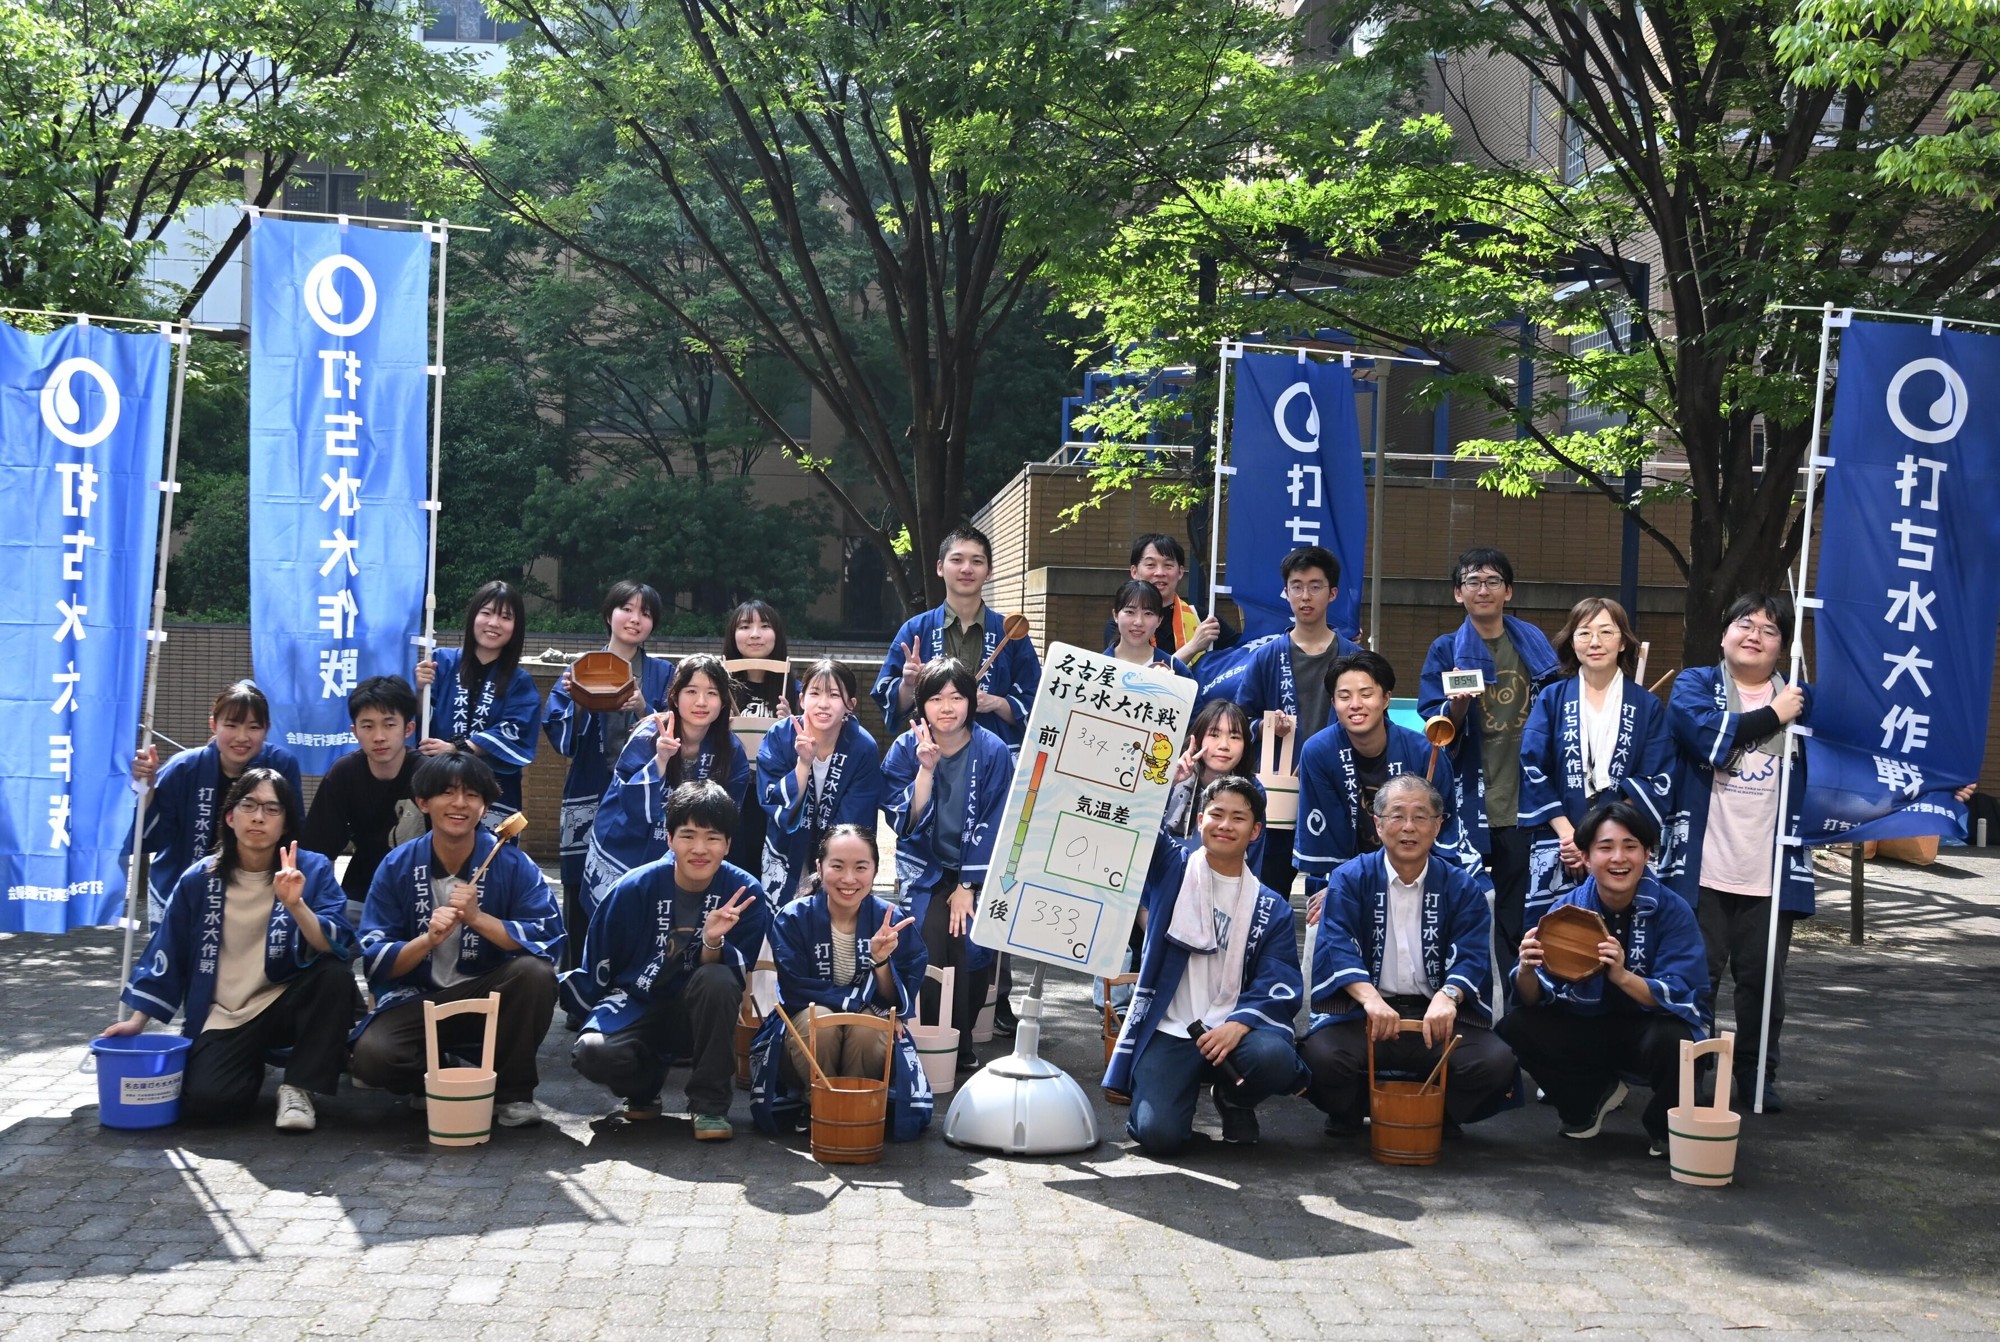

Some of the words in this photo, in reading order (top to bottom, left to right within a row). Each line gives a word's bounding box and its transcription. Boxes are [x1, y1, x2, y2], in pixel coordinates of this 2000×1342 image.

[1872, 454, 1948, 800] 打ち水大作戦
[1048, 677, 1181, 733] 打ち水大作戦
[1054, 653, 1118, 690] 名古屋
[1038, 725, 1060, 748] 前
[1563, 700, 1583, 789] 打ち水大作戦
[1607, 703, 1637, 793] 打ち水大作戦
[1075, 795, 1131, 825] 気温差
[199, 877, 223, 975] 打ち水大作戦
[635, 900, 673, 993] 打ち水大作戦
[988, 899, 1009, 922] 後
[1423, 892, 1440, 990] 打ち水大作戦
[814, 942, 832, 981] 打ち
